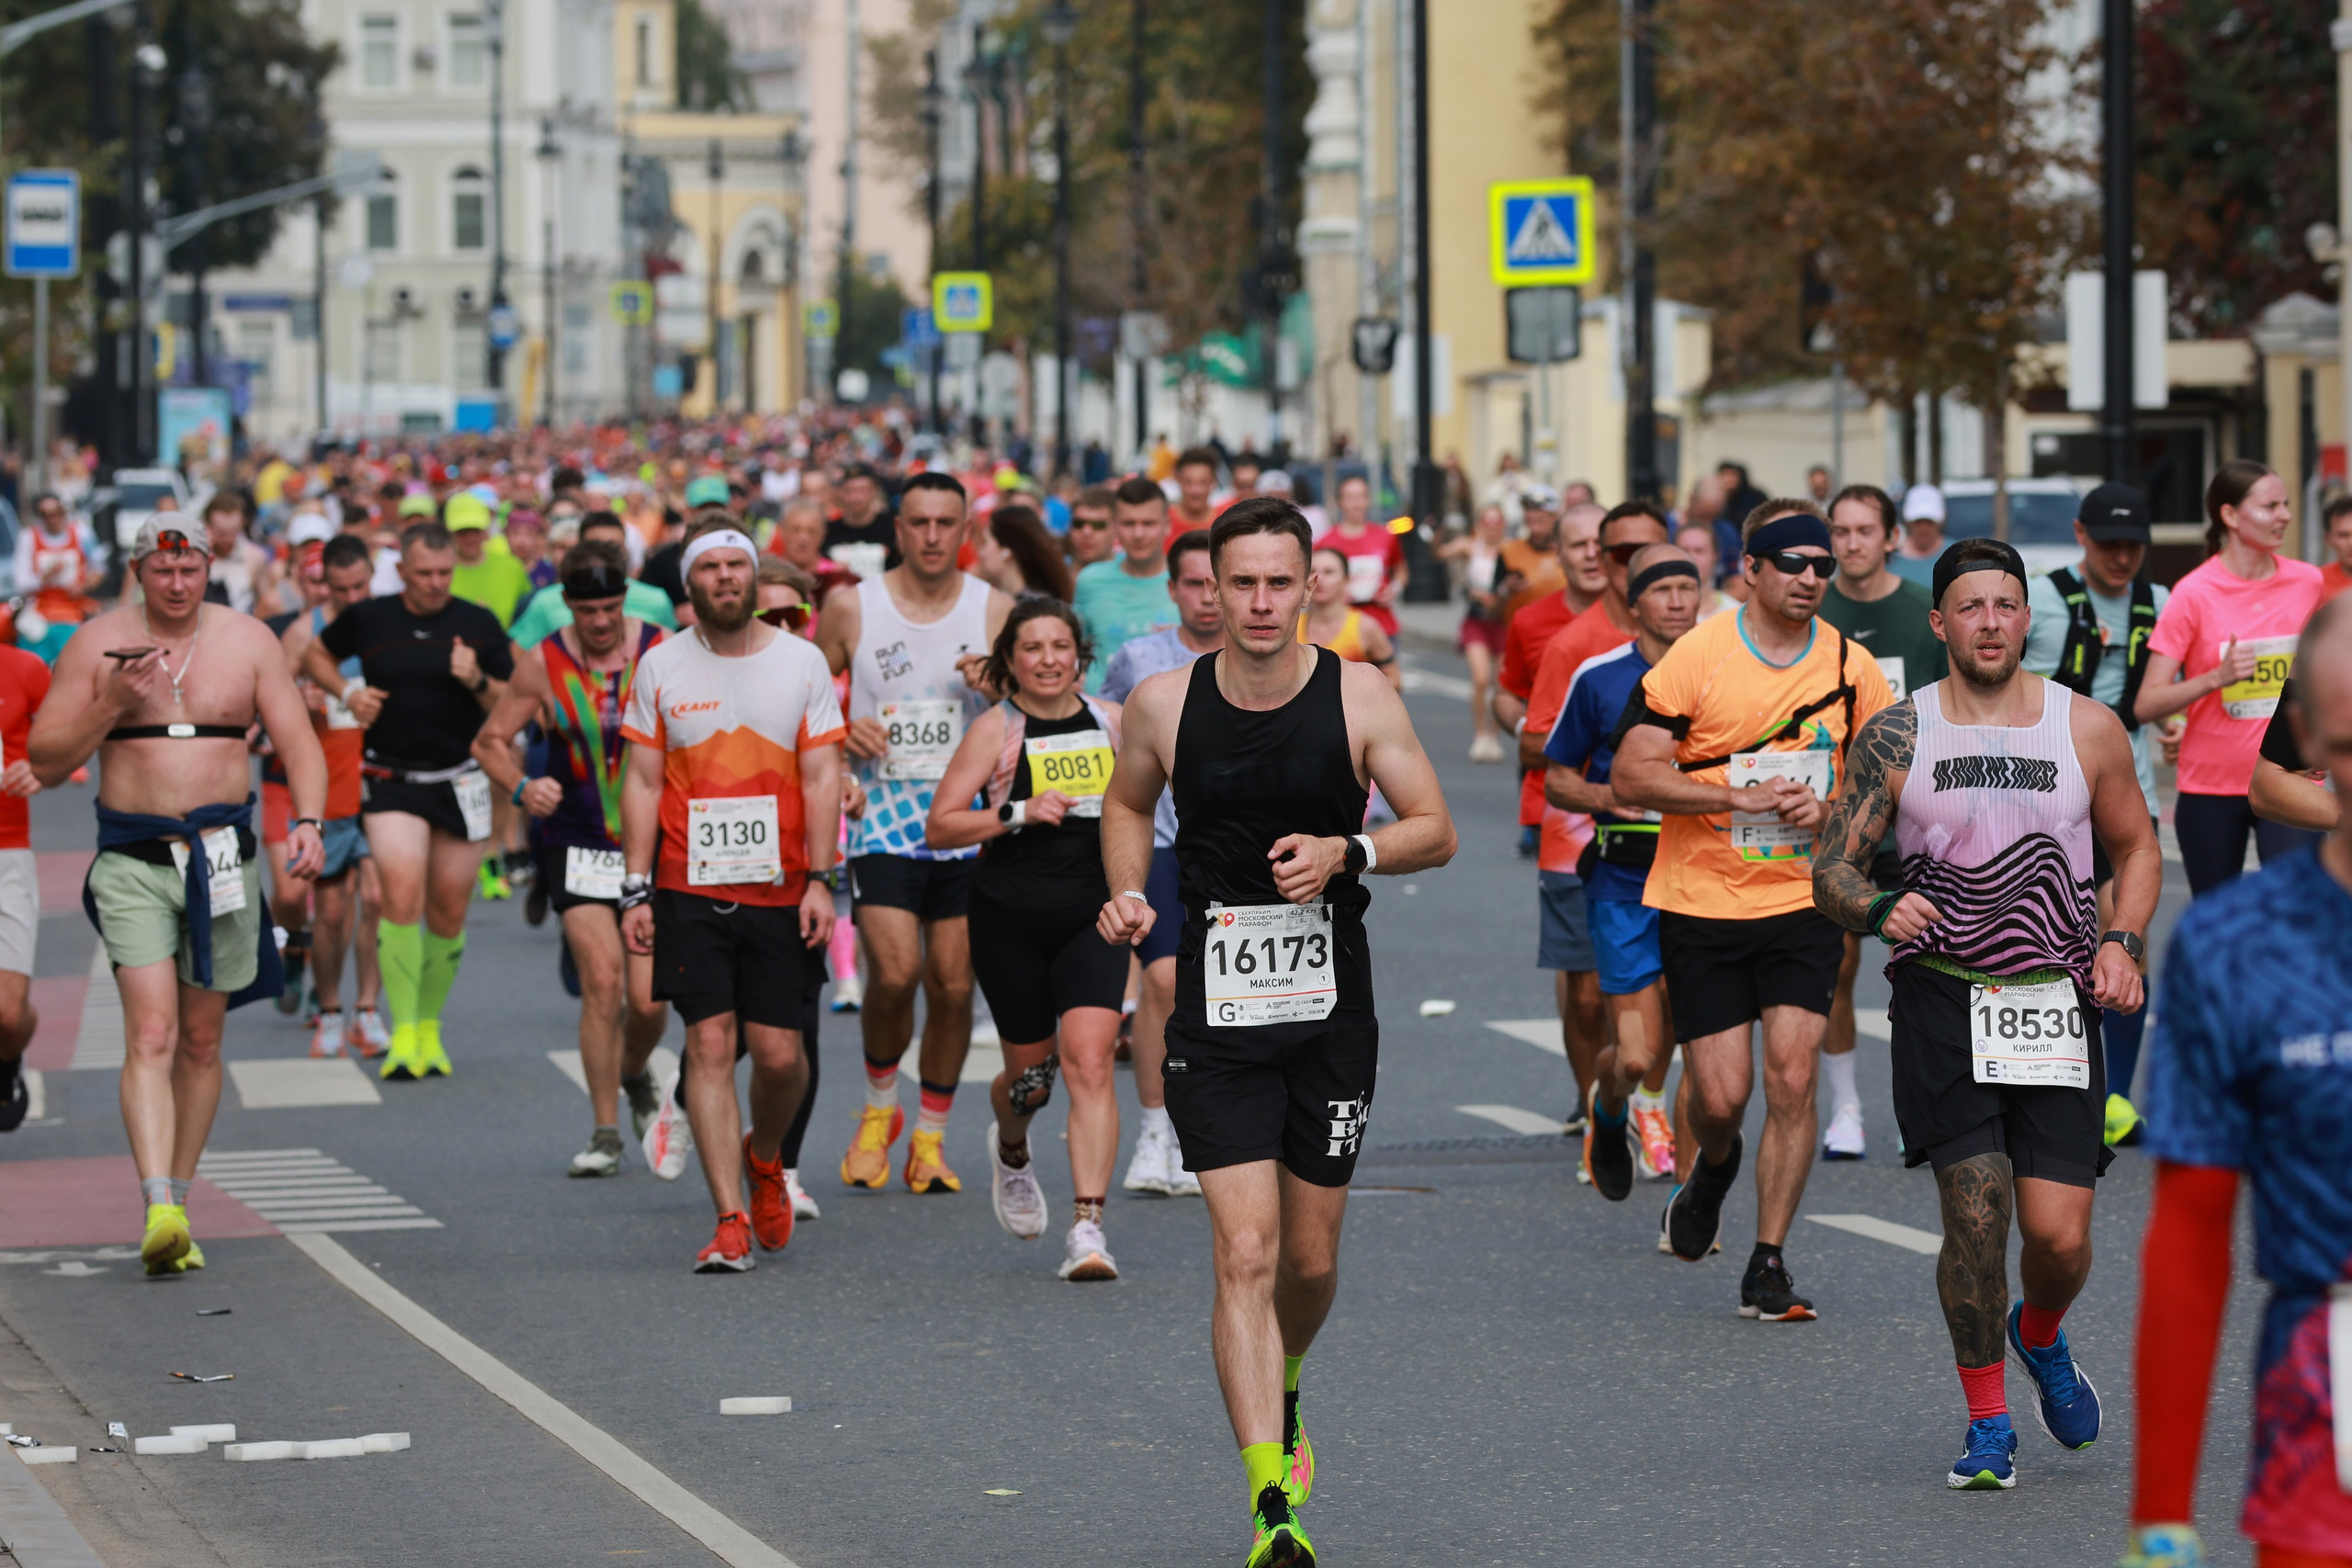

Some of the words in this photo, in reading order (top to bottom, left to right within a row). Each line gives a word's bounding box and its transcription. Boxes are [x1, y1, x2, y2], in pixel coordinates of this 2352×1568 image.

[888, 722, 951, 746] 8368
[1044, 752, 1104, 781] 8081
[1932, 759, 1953, 793] IN
[1951, 756, 1987, 789] RUN
[2007, 757, 2059, 793] TRUST
[699, 820, 766, 847] 3130
[1743, 828, 1753, 842] F
[1238, 913, 1283, 922] МОСКОВСКИЙ
[1211, 933, 1328, 976] 16173
[1250, 977, 1294, 989] МАКСИМ
[1218, 1002, 1236, 1022] G
[1978, 1006, 2084, 1040] 18530
[2013, 1044, 2052, 1053] КИРИЛЛ
[1985, 1061, 1998, 1077] E
